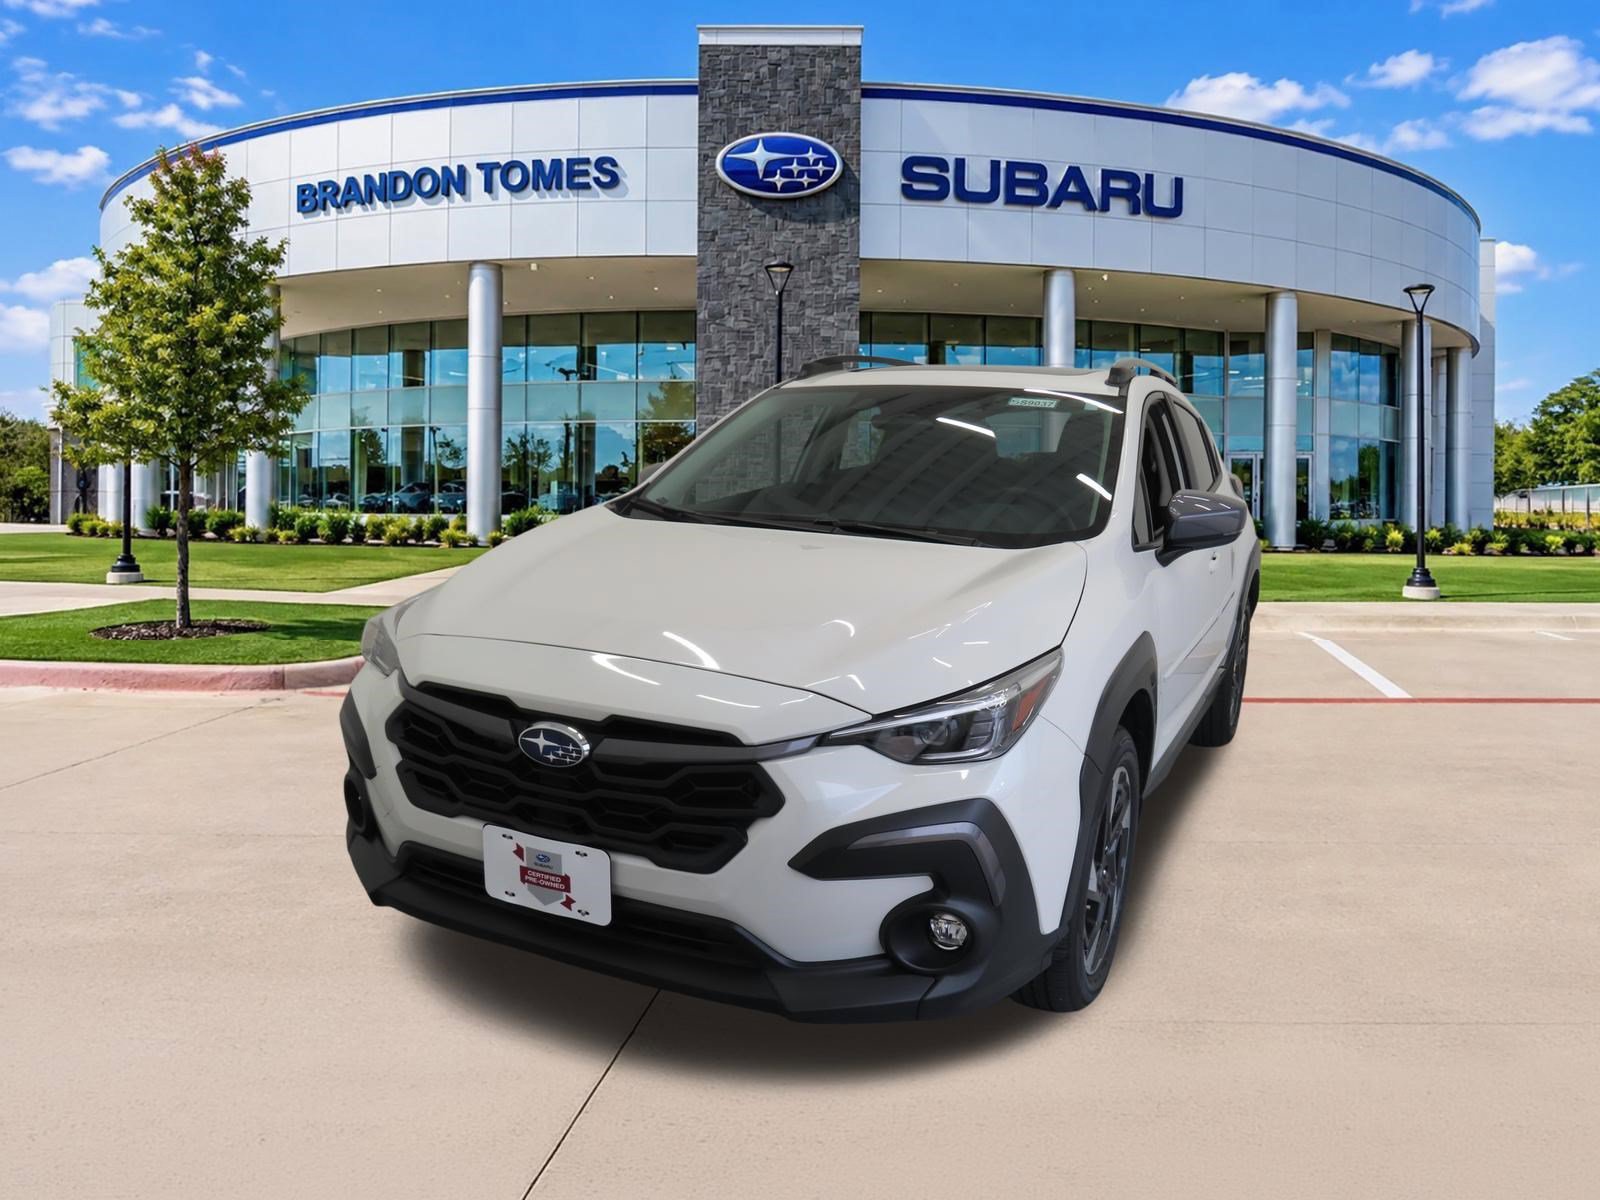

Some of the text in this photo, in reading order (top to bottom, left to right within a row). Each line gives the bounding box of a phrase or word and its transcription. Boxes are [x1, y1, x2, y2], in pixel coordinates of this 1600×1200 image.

[297, 156, 620, 213] BRANDON TOMES
[901, 155, 1184, 218] SUBARU
[525, 875, 566, 890] PRE-OWNED
[527, 870, 562, 883] CERTIFIED
